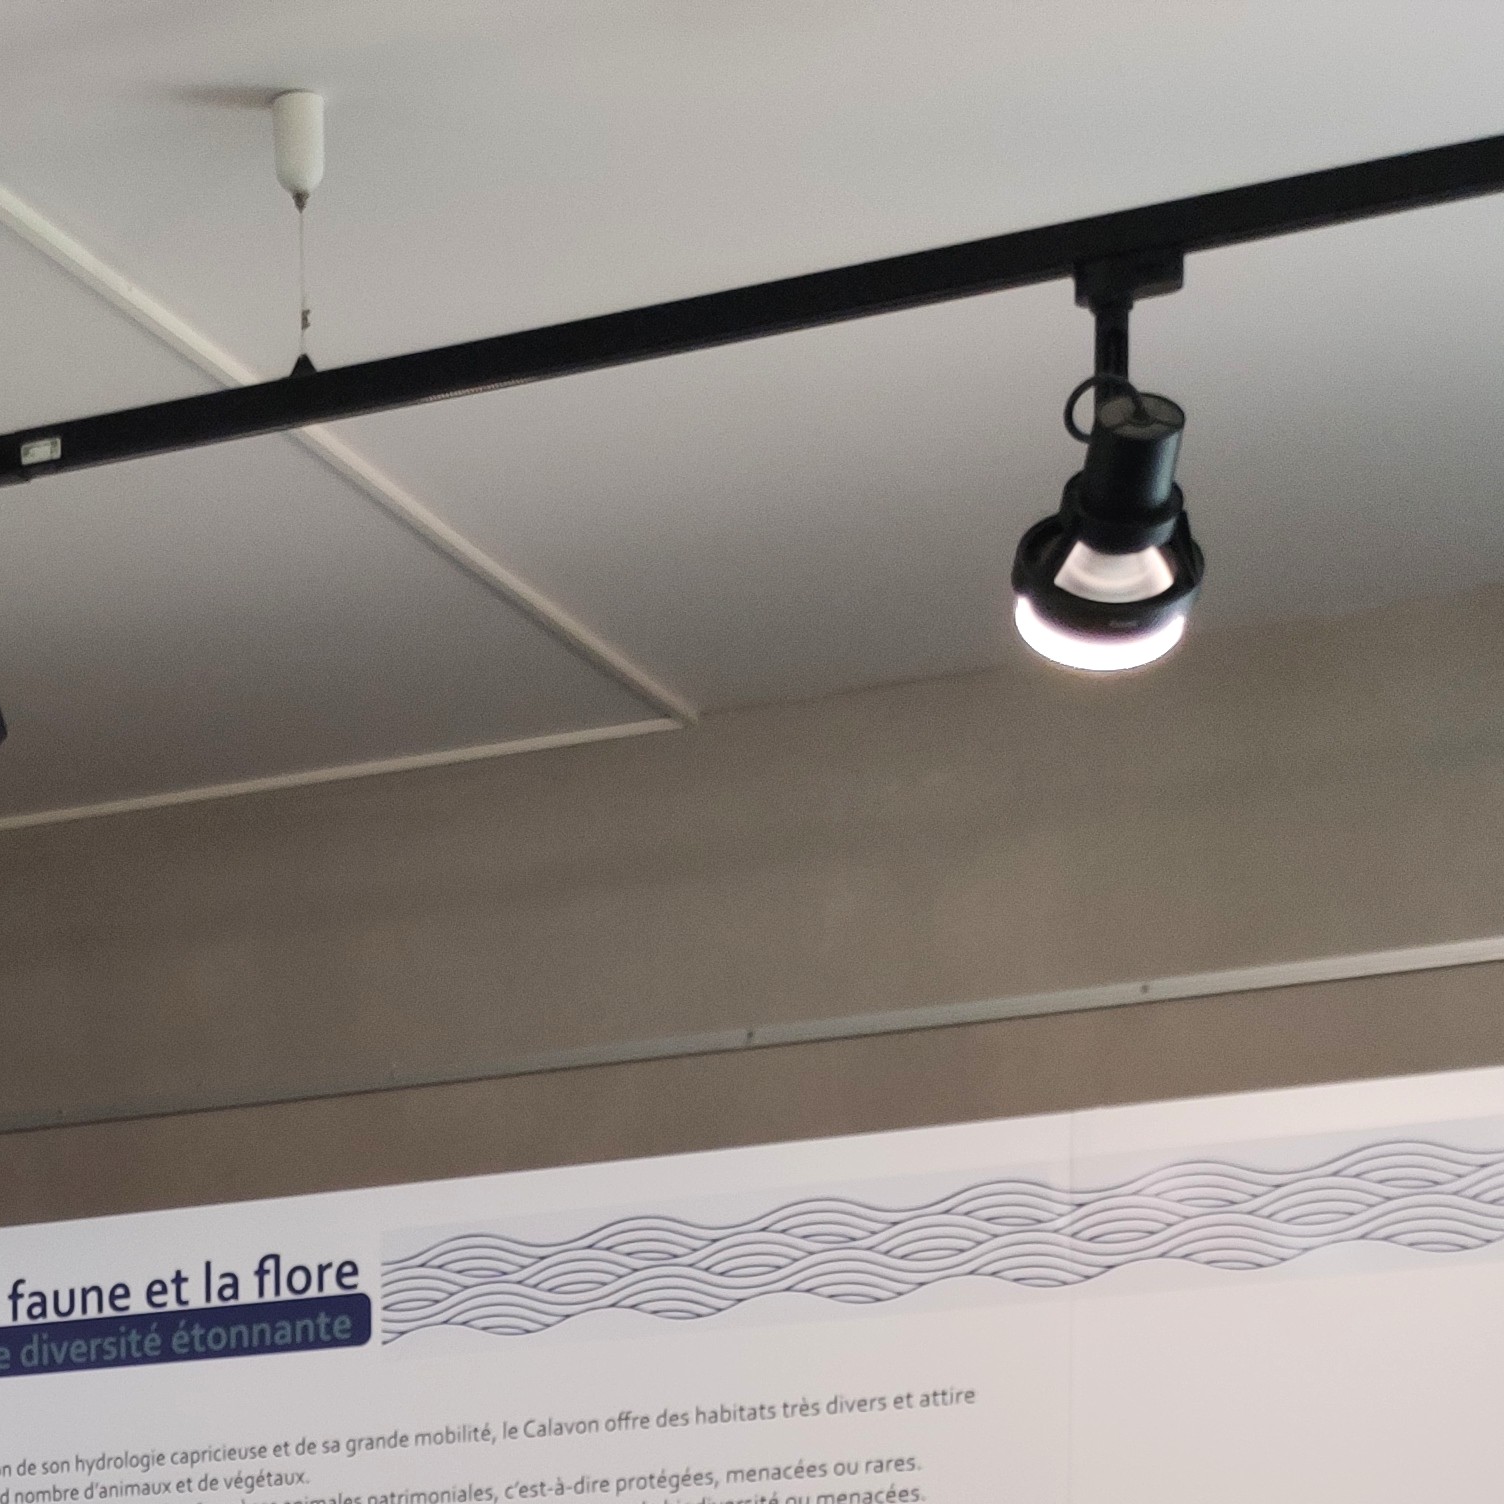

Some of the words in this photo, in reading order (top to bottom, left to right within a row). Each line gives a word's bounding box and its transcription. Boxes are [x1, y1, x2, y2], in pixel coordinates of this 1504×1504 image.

[7, 1278, 131, 1322] faune
[145, 1269, 189, 1309] et
[204, 1260, 239, 1303] la
[254, 1253, 359, 1298] flore
[20, 1322, 161, 1367] diversité
[171, 1311, 352, 1354] étonnante
[16, 1458, 37, 1476] de
[41, 1459, 70, 1475] son
[74, 1450, 165, 1476] hydrologie
[170, 1444, 267, 1468] capricieuse
[272, 1440, 290, 1458] et
[294, 1436, 317, 1456] de
[321, 1439, 340, 1454] sa
[345, 1429, 409, 1458] grande
[414, 1422, 496, 1446] mobilité,
[502, 1421, 518, 1439] le
[522, 1417, 599, 1438] Calavon
[604, 1411, 650, 1432] offre
[655, 1408, 689, 1428] des
[695, 1403, 776, 1424] habitats
[782, 1398, 820, 1418] très
[826, 1396, 887, 1415] divers
[892, 1392, 913, 1410] et
[919, 1389, 975, 1407] attire
[14, 1484, 79, 1504] nombre
[175, 1477, 193, 1493] et
[197, 1473, 219, 1492] de
